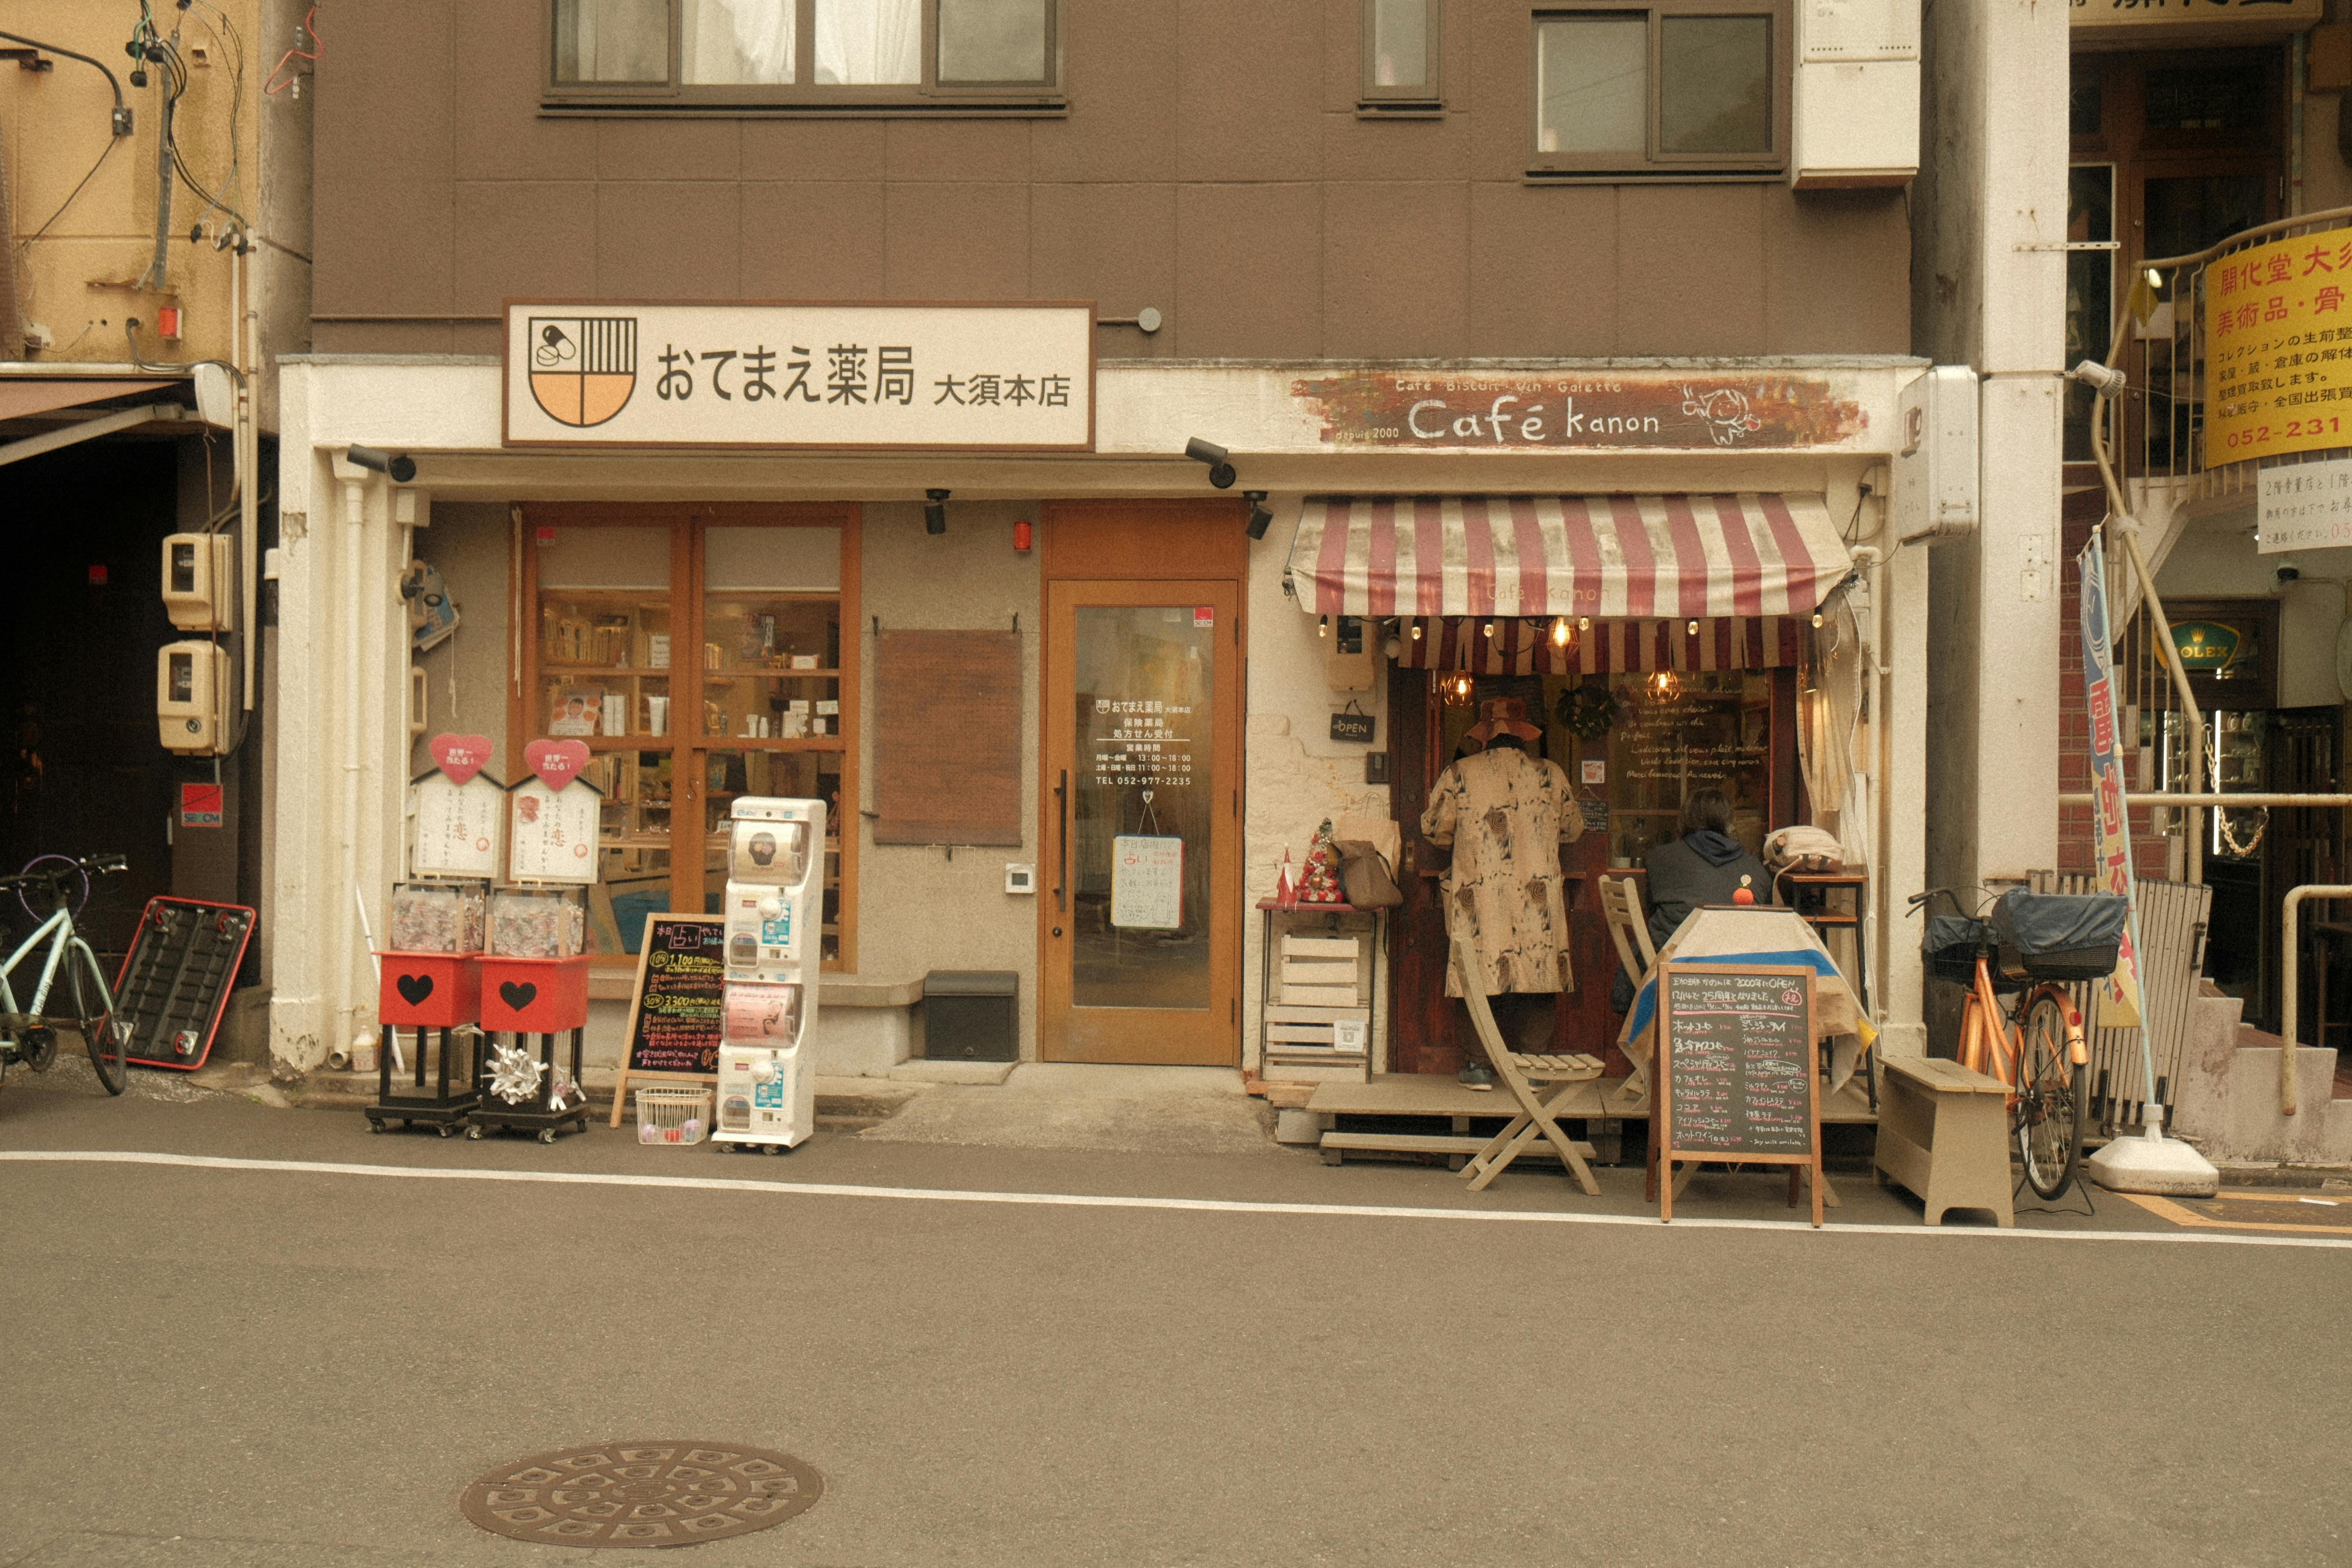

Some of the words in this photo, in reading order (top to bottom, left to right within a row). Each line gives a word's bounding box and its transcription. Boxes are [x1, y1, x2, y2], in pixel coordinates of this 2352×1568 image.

[2220, 253, 2292, 298] 開化堂
[2216, 286, 2345, 338] 美術品・骨
[2219, 327, 2352, 363] コレクションの生前整
[2219, 347, 2352, 383] 家屋・蔵・倉庫の解体
[656, 343, 916, 406] おてまえ薬局
[933, 374, 1071, 407] 大須本店
[1395, 379, 1432, 392] Café
[2219, 372, 2328, 402] 整理買取致します。
[1407, 395, 1546, 443] Café
[1565, 396, 1659, 438] kanon
[1335, 430, 1370, 442] depuis
[1372, 428, 1399, 438] 2000
[2227, 415, 2340, 449] 052-231
[1486, 583, 1525, 600] Café
[2180, 646, 2228, 658] OLEX
[1112, 700, 1162, 714] おてまえ薬局
[1124, 718, 1163, 727] 保険薬局
[1338, 723, 1367, 733] OPEN
[1113, 729, 1173, 739] 処方せん受付
[1126, 743, 1161, 752] 営業時間
[1117, 777, 1191, 785] 052-977-2235
[1119, 838, 1174, 850] 本日店内にて
[1124, 851, 1148, 865] 占い
[657, 925, 672, 937] 本日
[673, 926, 698, 947] 占い
[1674, 1074, 1708, 1084] カフェオレ
[1676, 1116, 1719, 1124] アイリッシュコーヒー
